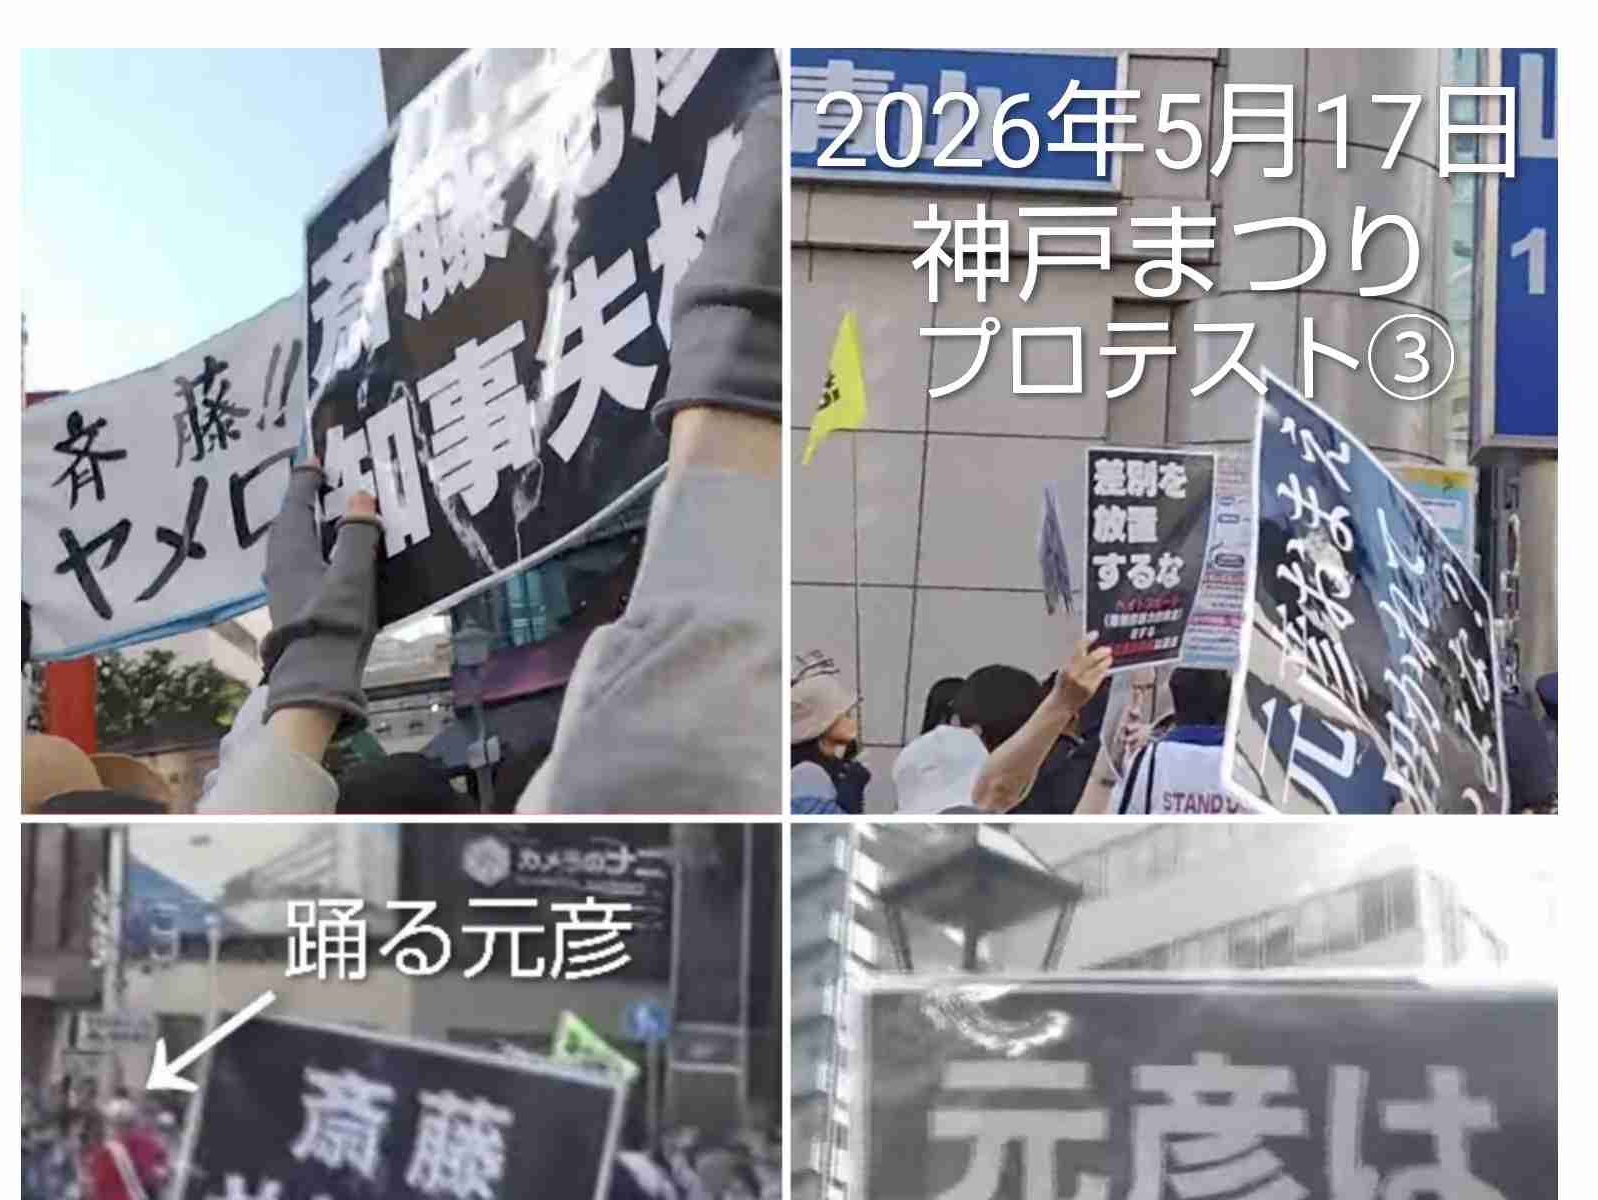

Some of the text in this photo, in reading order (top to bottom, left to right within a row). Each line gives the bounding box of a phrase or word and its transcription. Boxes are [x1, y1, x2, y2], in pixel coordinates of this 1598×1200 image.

[1094, 457, 1187, 499] 差別を
[54, 447, 299, 620] ヤメロ
[1092, 503, 1159, 544] 放置
[1092, 551, 1185, 592] するな
[1162, 791, 1223, 815] STAND
